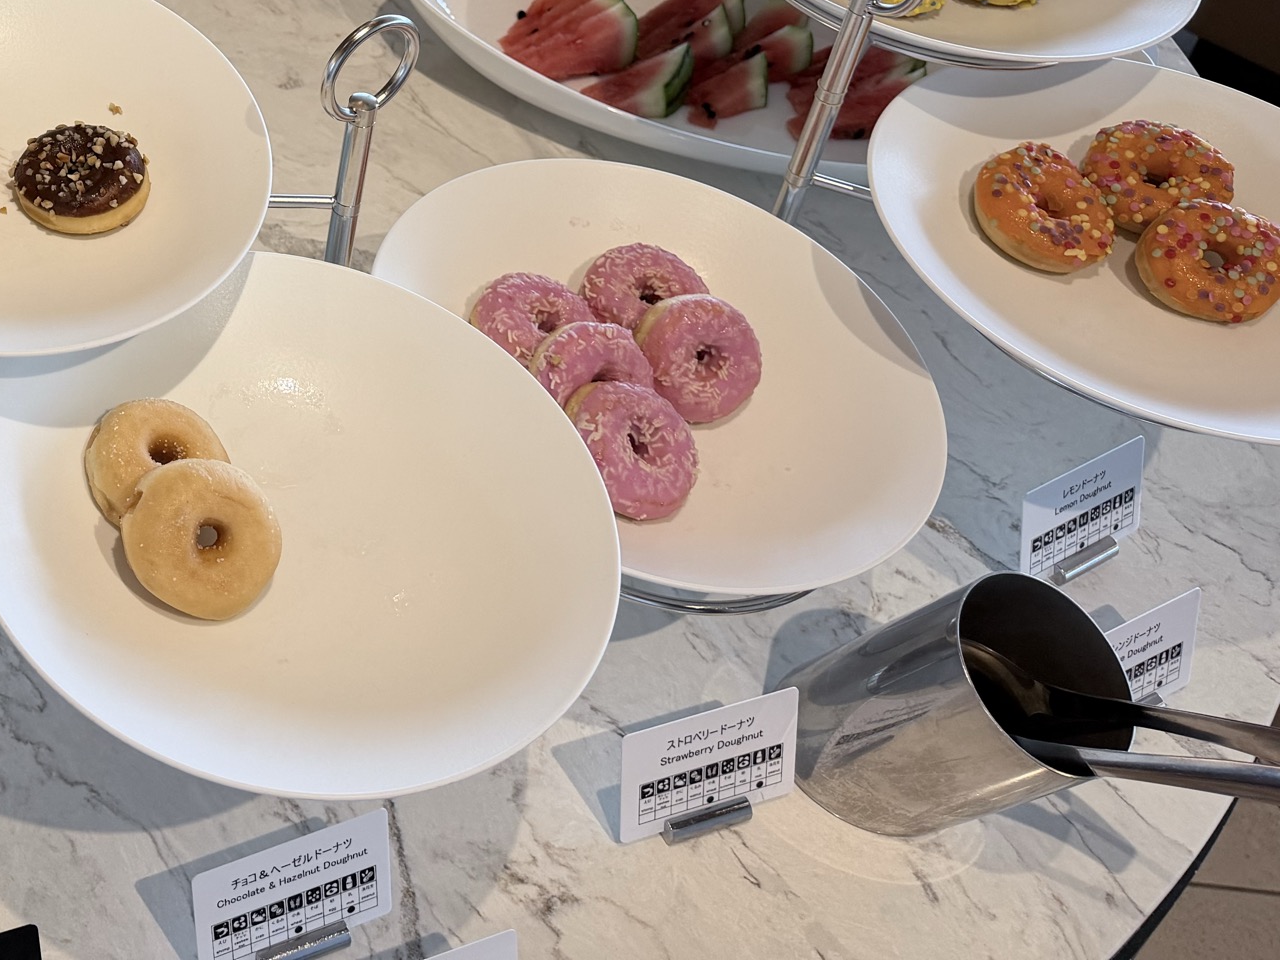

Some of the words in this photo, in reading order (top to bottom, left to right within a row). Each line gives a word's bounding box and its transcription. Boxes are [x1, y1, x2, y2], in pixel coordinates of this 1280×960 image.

[1055, 500, 1078, 516] Lemon
[1080, 481, 1112, 502] Doughnut
[1063, 470, 1106, 498] レモンドーナツ
[1127, 635, 1163, 659] Doughnut
[660, 745, 715, 766] Strawberry
[717, 730, 764, 750] Doughnut
[666, 716, 755, 751] ストロベリードーナツ
[216, 886, 266, 909] Chocolate
[268, 881, 276, 889] &
[279, 866, 321, 886] Hazelnut
[323, 848, 368, 870] Doughnut
